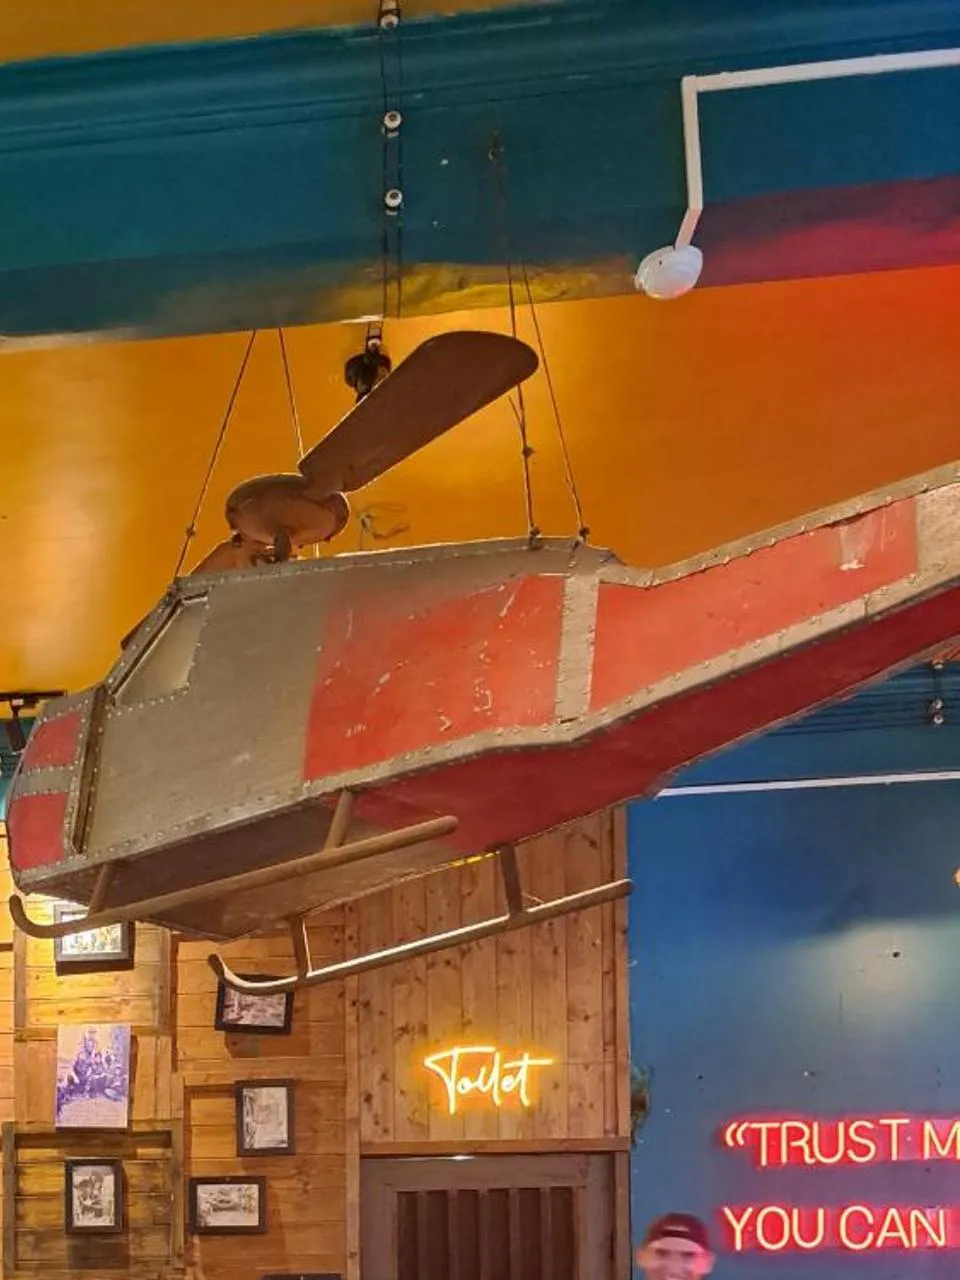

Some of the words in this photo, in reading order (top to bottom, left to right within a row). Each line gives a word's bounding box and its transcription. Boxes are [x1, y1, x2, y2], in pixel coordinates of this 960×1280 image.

[424, 1045, 553, 1115] Toilet
[723, 1206, 825, 1251] YOU
[839, 1206, 946, 1250] CAN
